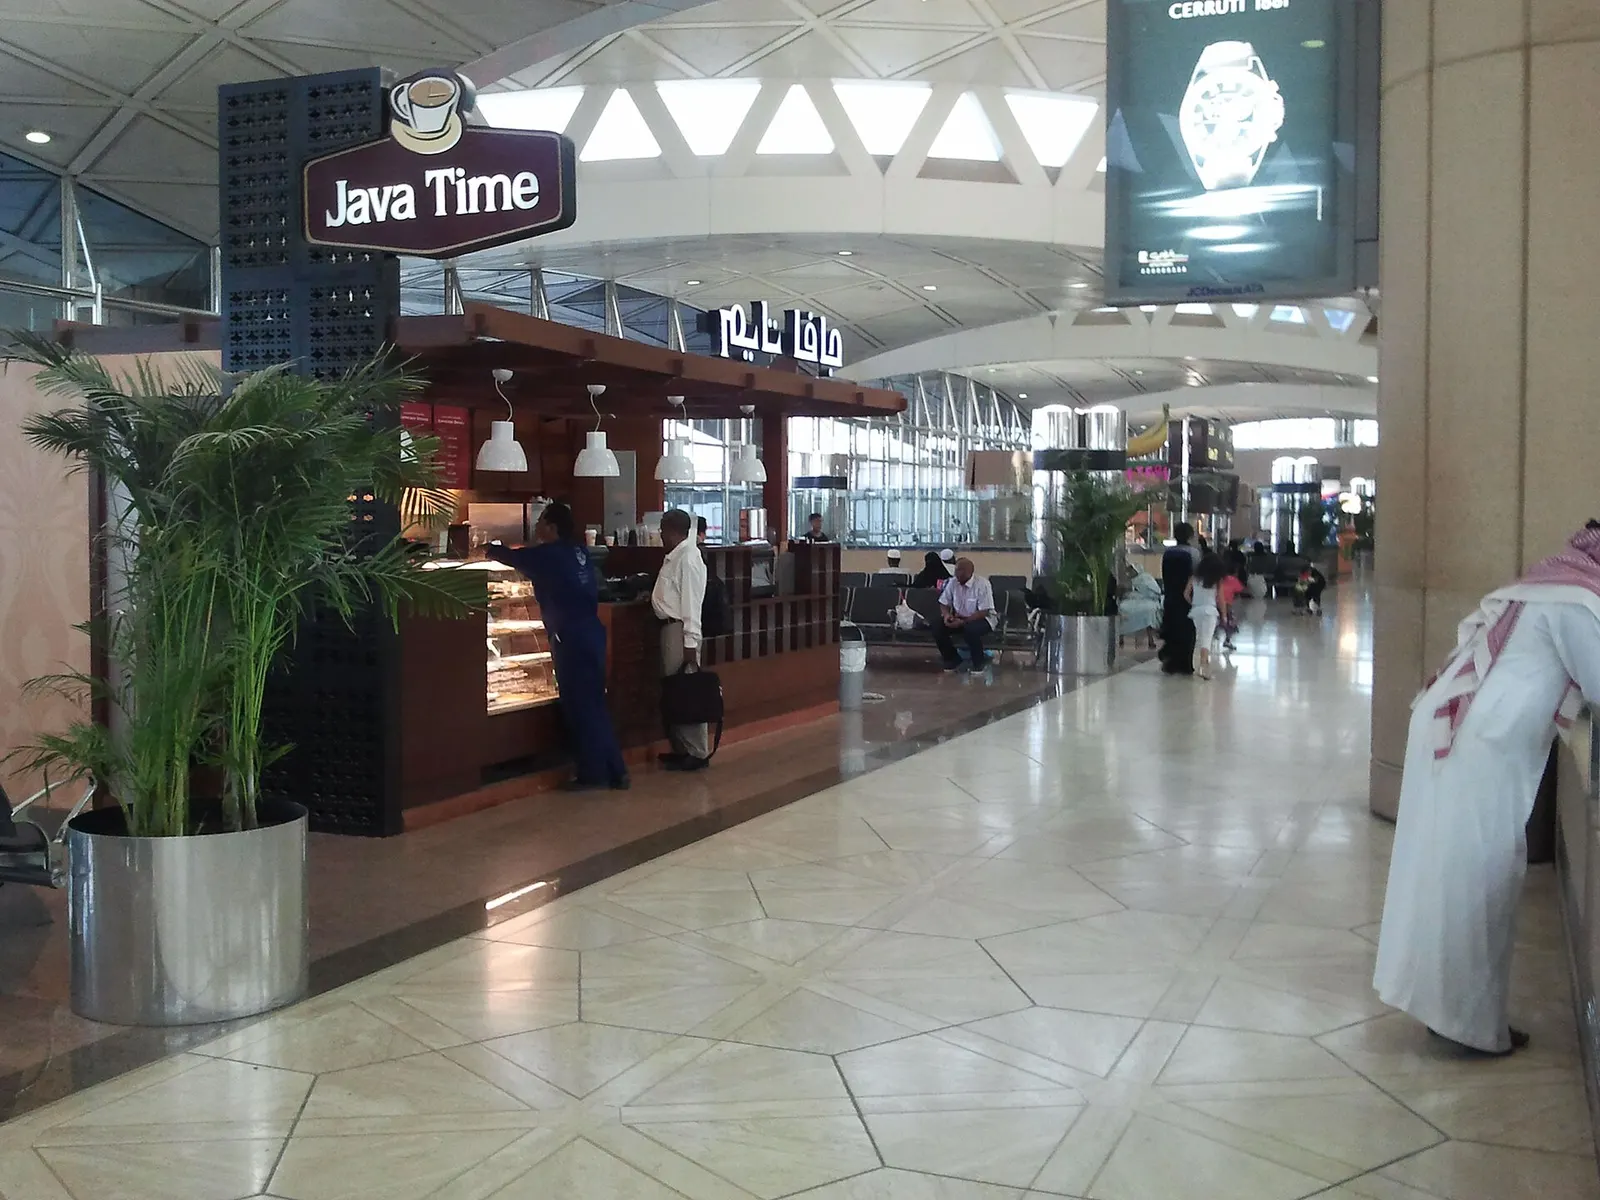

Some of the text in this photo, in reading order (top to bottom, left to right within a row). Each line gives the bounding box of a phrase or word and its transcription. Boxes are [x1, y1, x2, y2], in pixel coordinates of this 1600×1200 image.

[1168, 0, 1246, 19] CERRUTI
[325, 167, 540, 228] Java Time
[719, 300, 843, 377] جافا تايم
